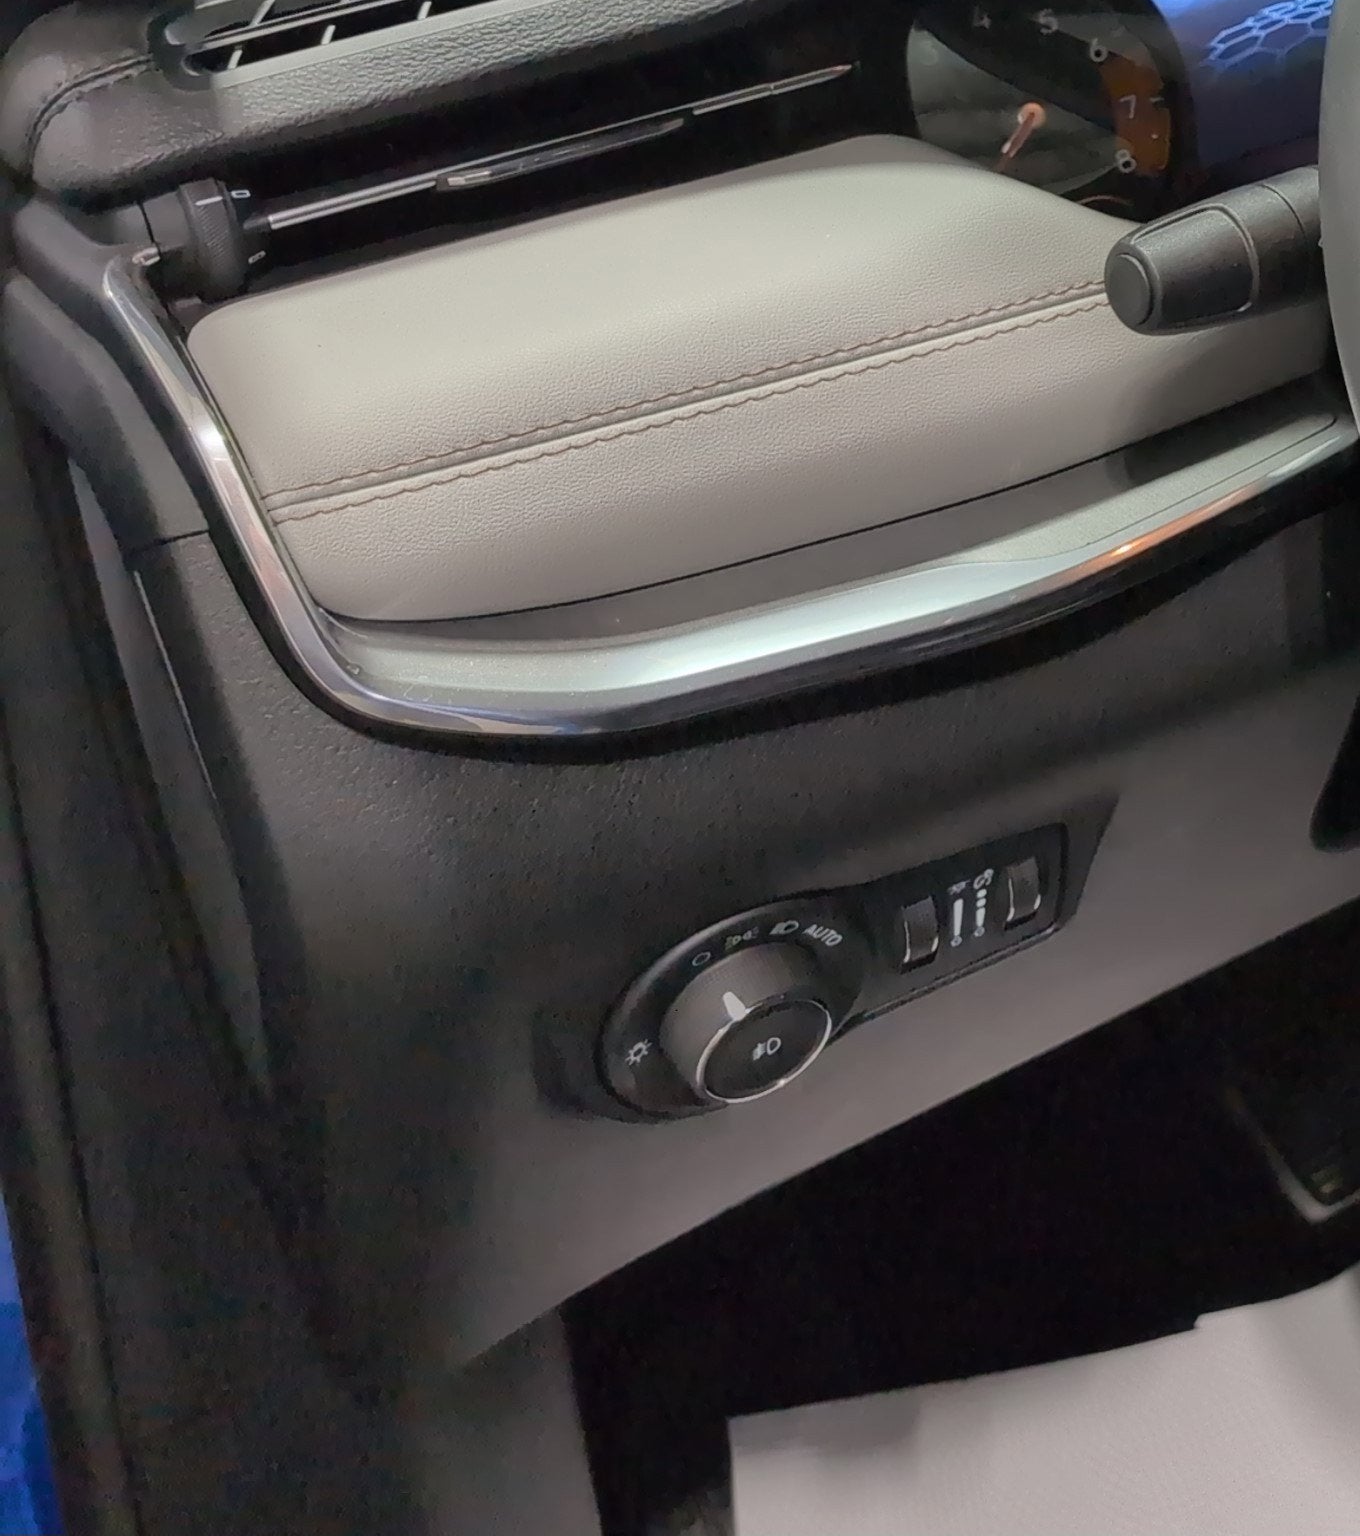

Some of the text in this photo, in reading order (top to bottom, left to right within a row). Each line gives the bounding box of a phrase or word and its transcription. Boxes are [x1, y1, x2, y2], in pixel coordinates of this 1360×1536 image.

[1039, 8, 1059, 36] 5
[1089, 38, 1108, 63] 6
[1119, 94, 1137, 119] 7
[1115, 149, 1137, 173] 8
[802, 924, 843, 947] AUTO
